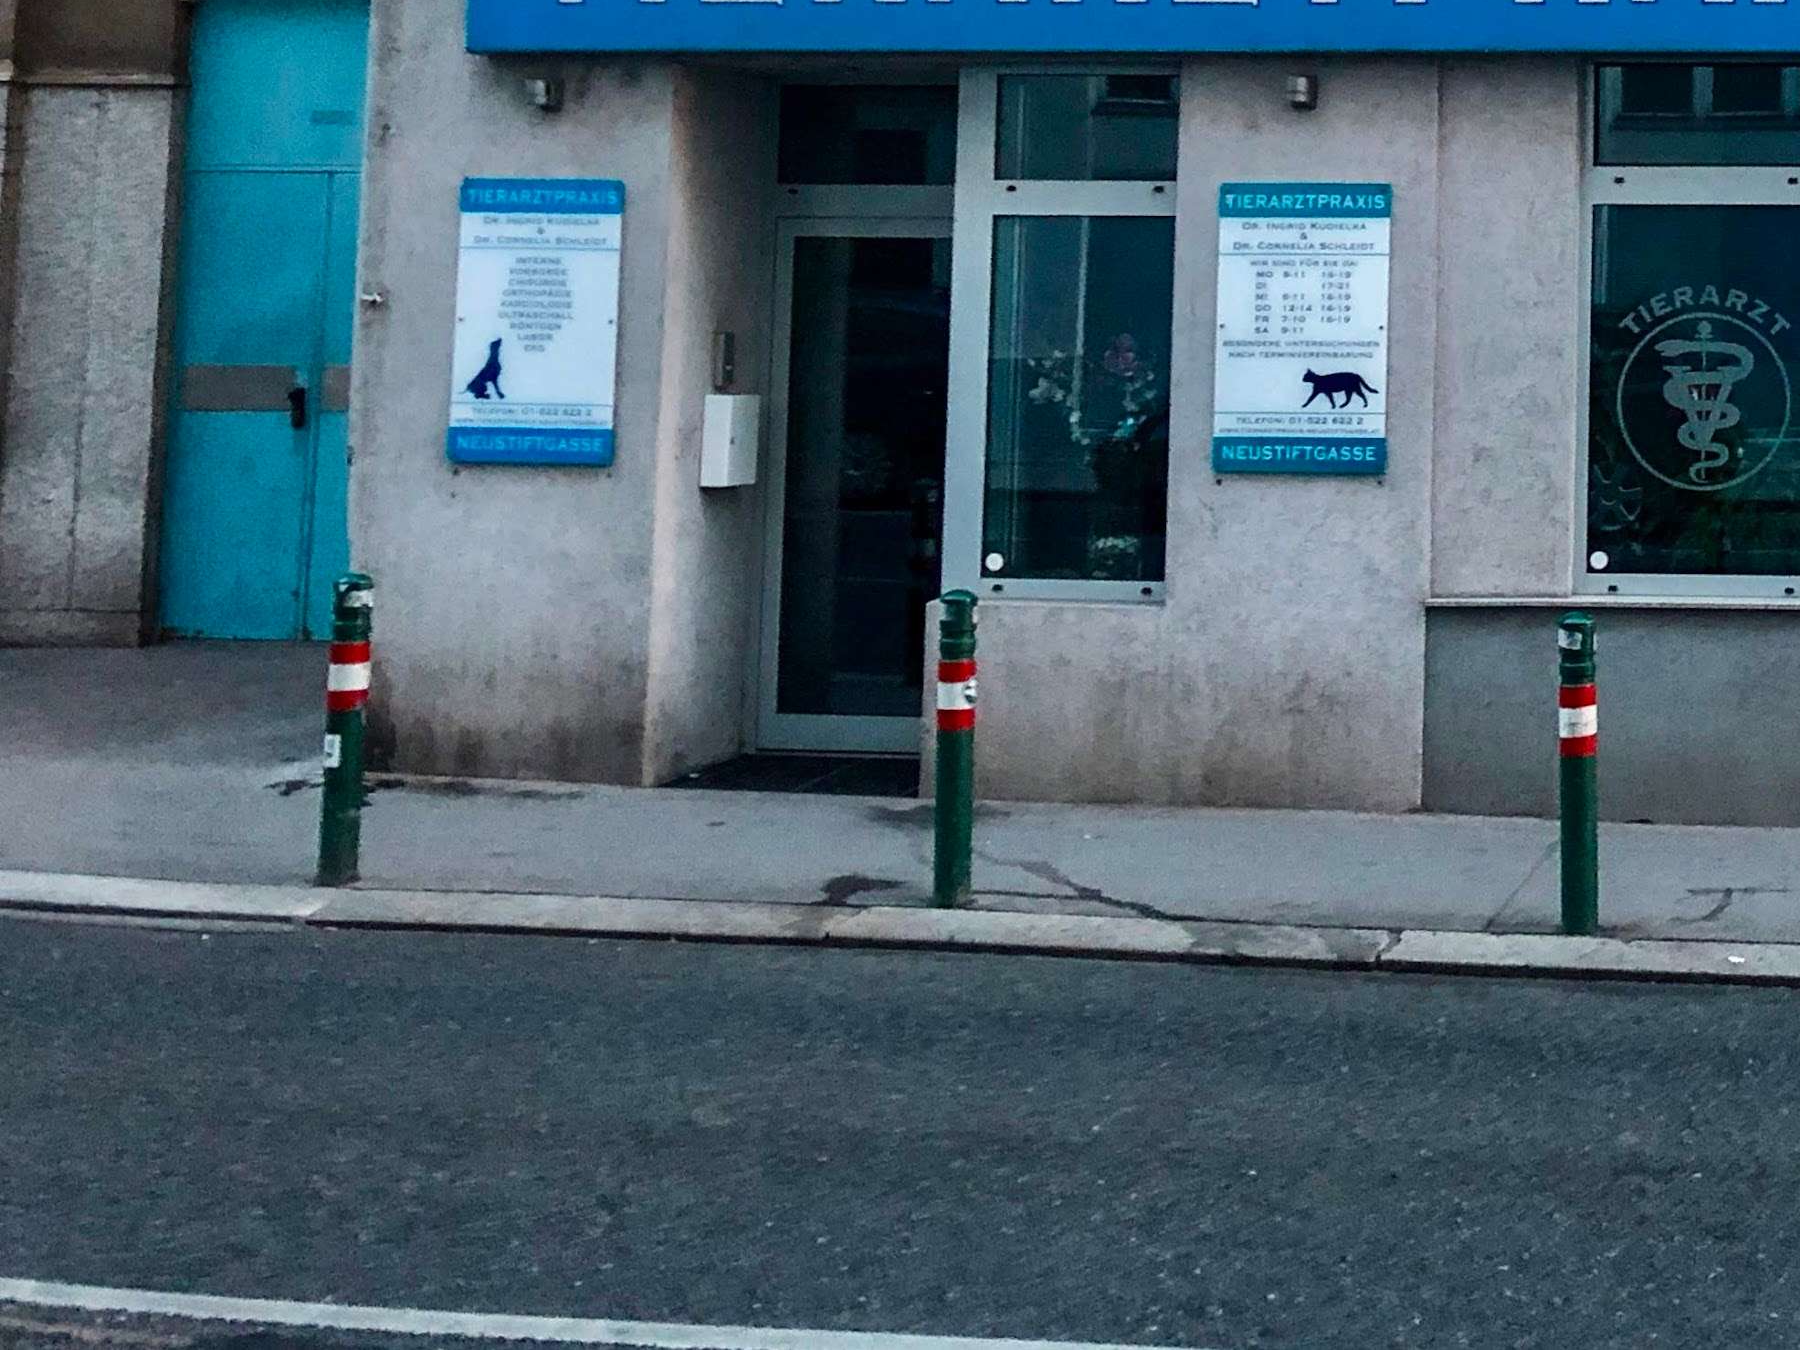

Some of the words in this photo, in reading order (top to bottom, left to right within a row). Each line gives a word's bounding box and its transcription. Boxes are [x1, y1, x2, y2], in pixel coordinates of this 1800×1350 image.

[466, 188, 618, 205] TIERARZTPRAXIS
[1225, 194, 1386, 209] TIERARZTPRAXIS
[1242, 222, 1261, 230] DR.
[1233, 242, 1253, 250] DR.
[1257, 242, 1315, 250] CORNELIA
[1319, 242, 1375, 250] SCHLEIDT
[1618, 284, 1792, 336] TIERARZT
[457, 436, 603, 452] NEUSTIFTGASSE
[1222, 445, 1376, 461] NEUSTIFTGASSE
